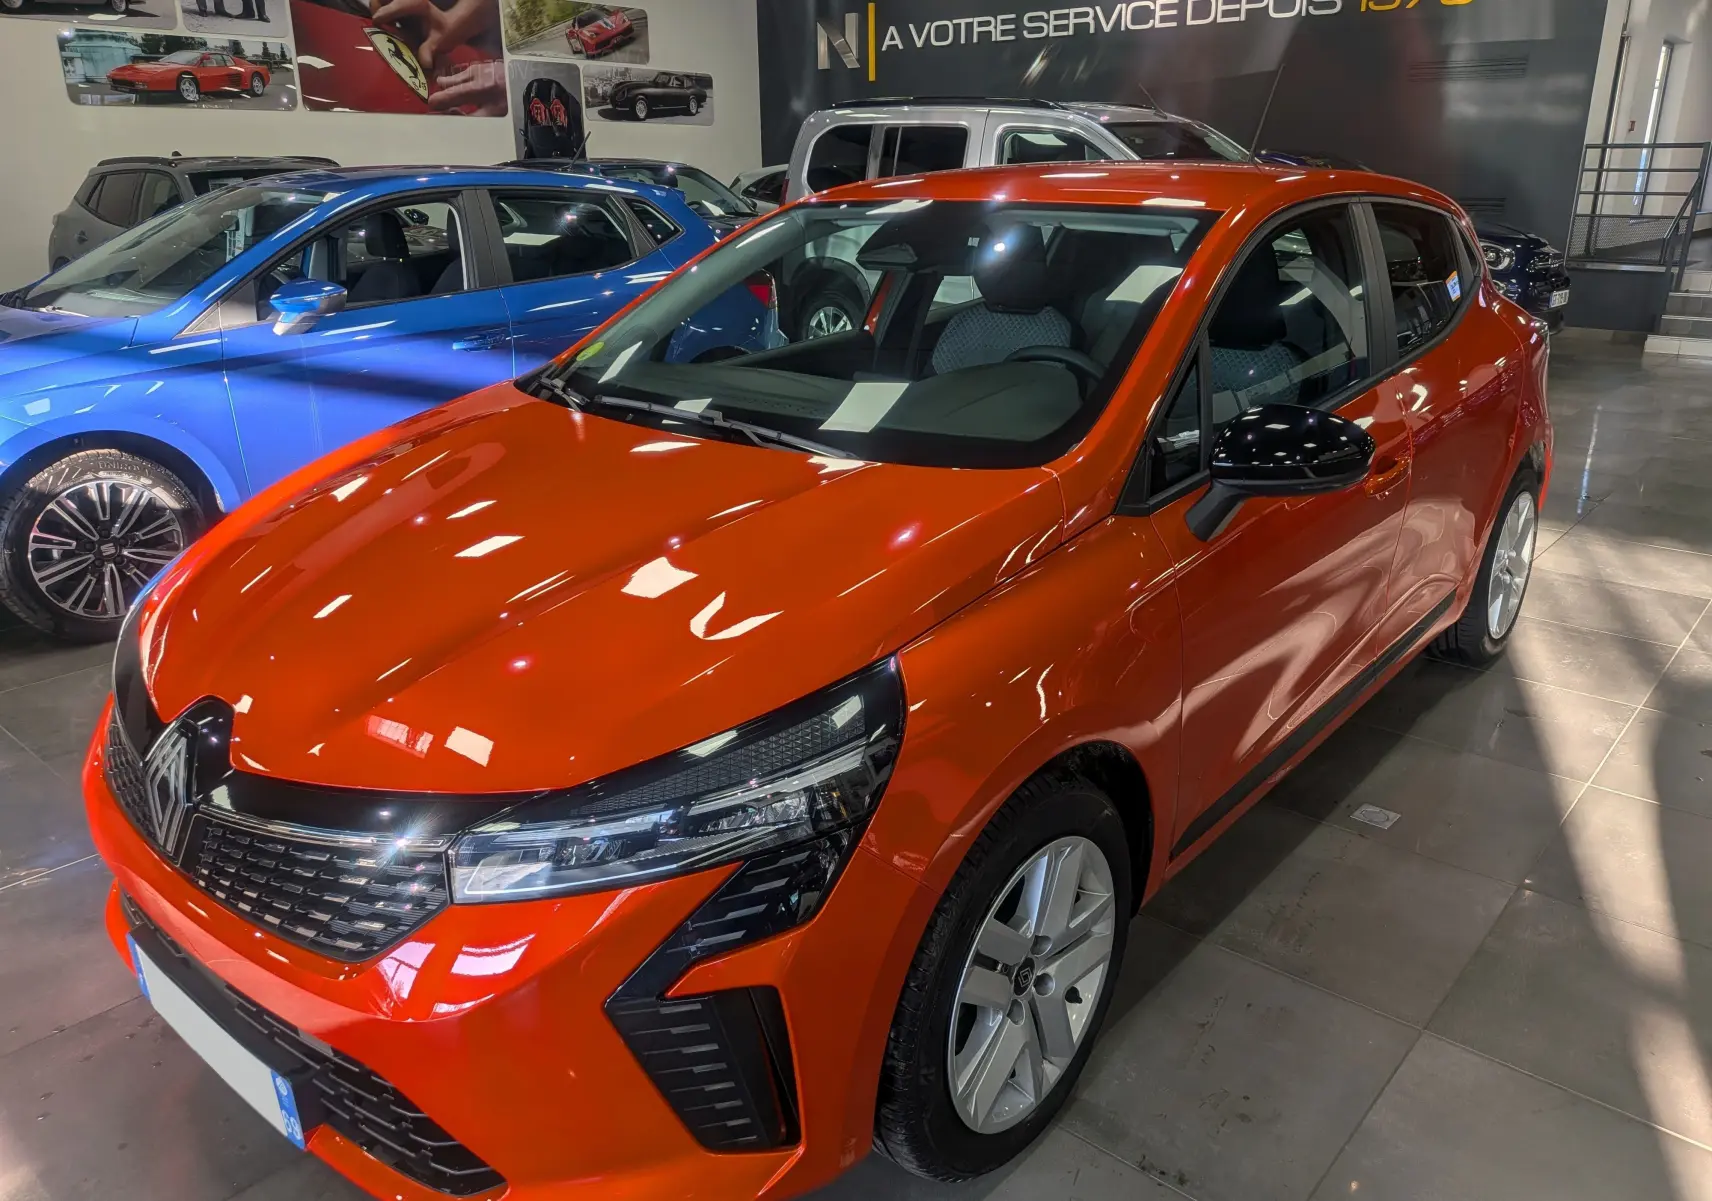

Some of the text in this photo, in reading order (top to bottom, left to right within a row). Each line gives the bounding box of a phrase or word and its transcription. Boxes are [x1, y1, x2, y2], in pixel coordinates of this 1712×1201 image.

[882, 25, 904, 51] A
[909, 13, 1016, 48] VOTRE
[1023, 0, 1178, 39] SERVICE
